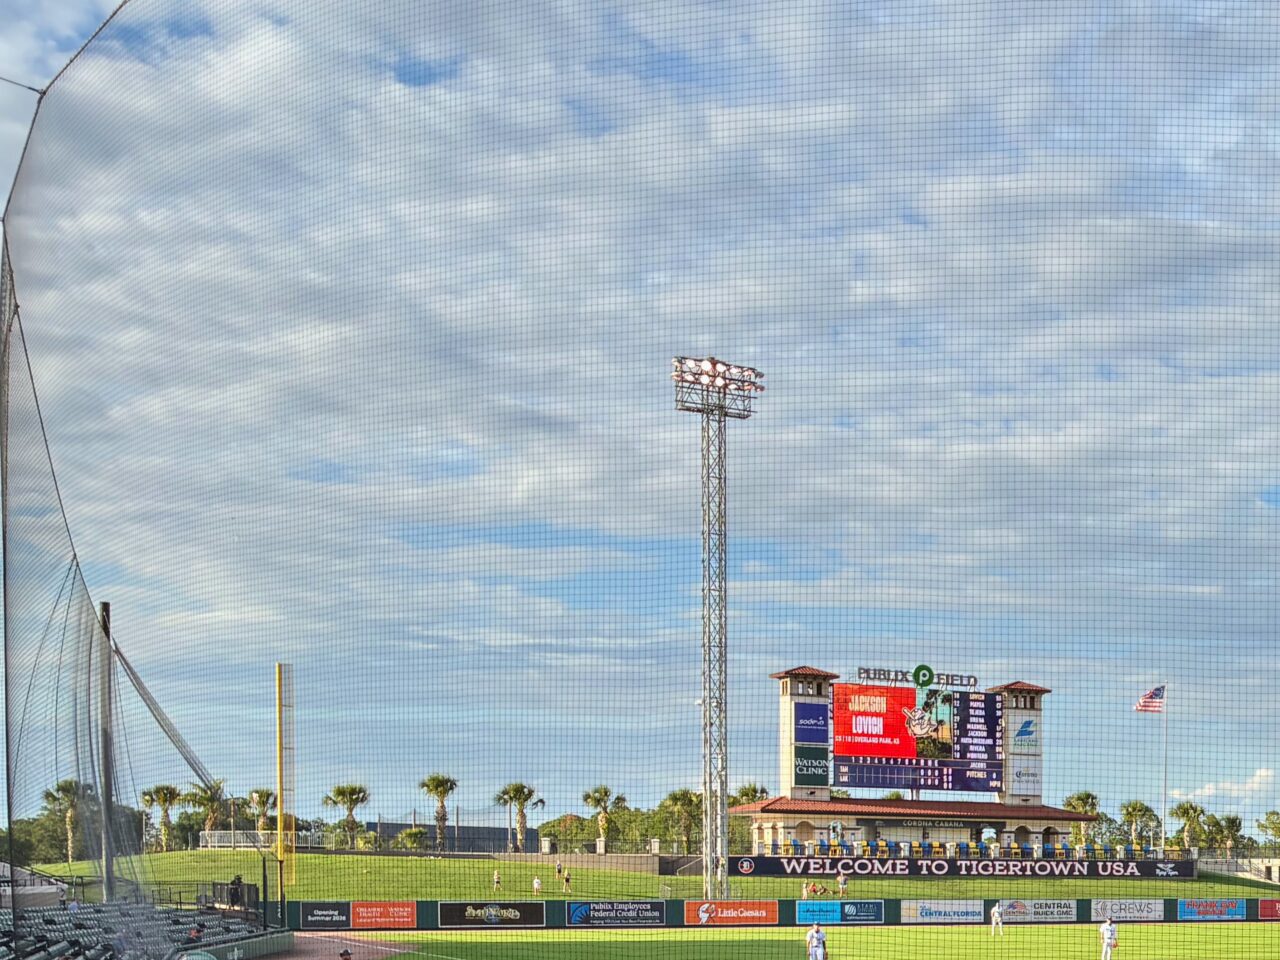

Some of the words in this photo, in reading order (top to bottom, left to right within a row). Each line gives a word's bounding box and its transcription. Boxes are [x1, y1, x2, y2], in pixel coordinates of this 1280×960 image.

[858, 666, 911, 682] PUBLIX
[936, 673, 978, 687] FIELD
[848, 694, 887, 713] JACKSON
[852, 715, 884, 735] LOVICH
[795, 757, 829, 766] WATSON
[796, 766, 828, 775] CLINIC
[781, 858, 909, 875] WELCOME
[917, 859, 949, 875] TO
[957, 860, 1088, 876] TIGERTOWN
[1098, 861, 1141, 876] USA
[613, 903, 651, 912] Employees
[1033, 902, 1073, 910] CENTRAL
[1110, 902, 1153, 914] CREWS
[718, 908, 738, 917] Little
[738, 908, 767, 917] Caesars
